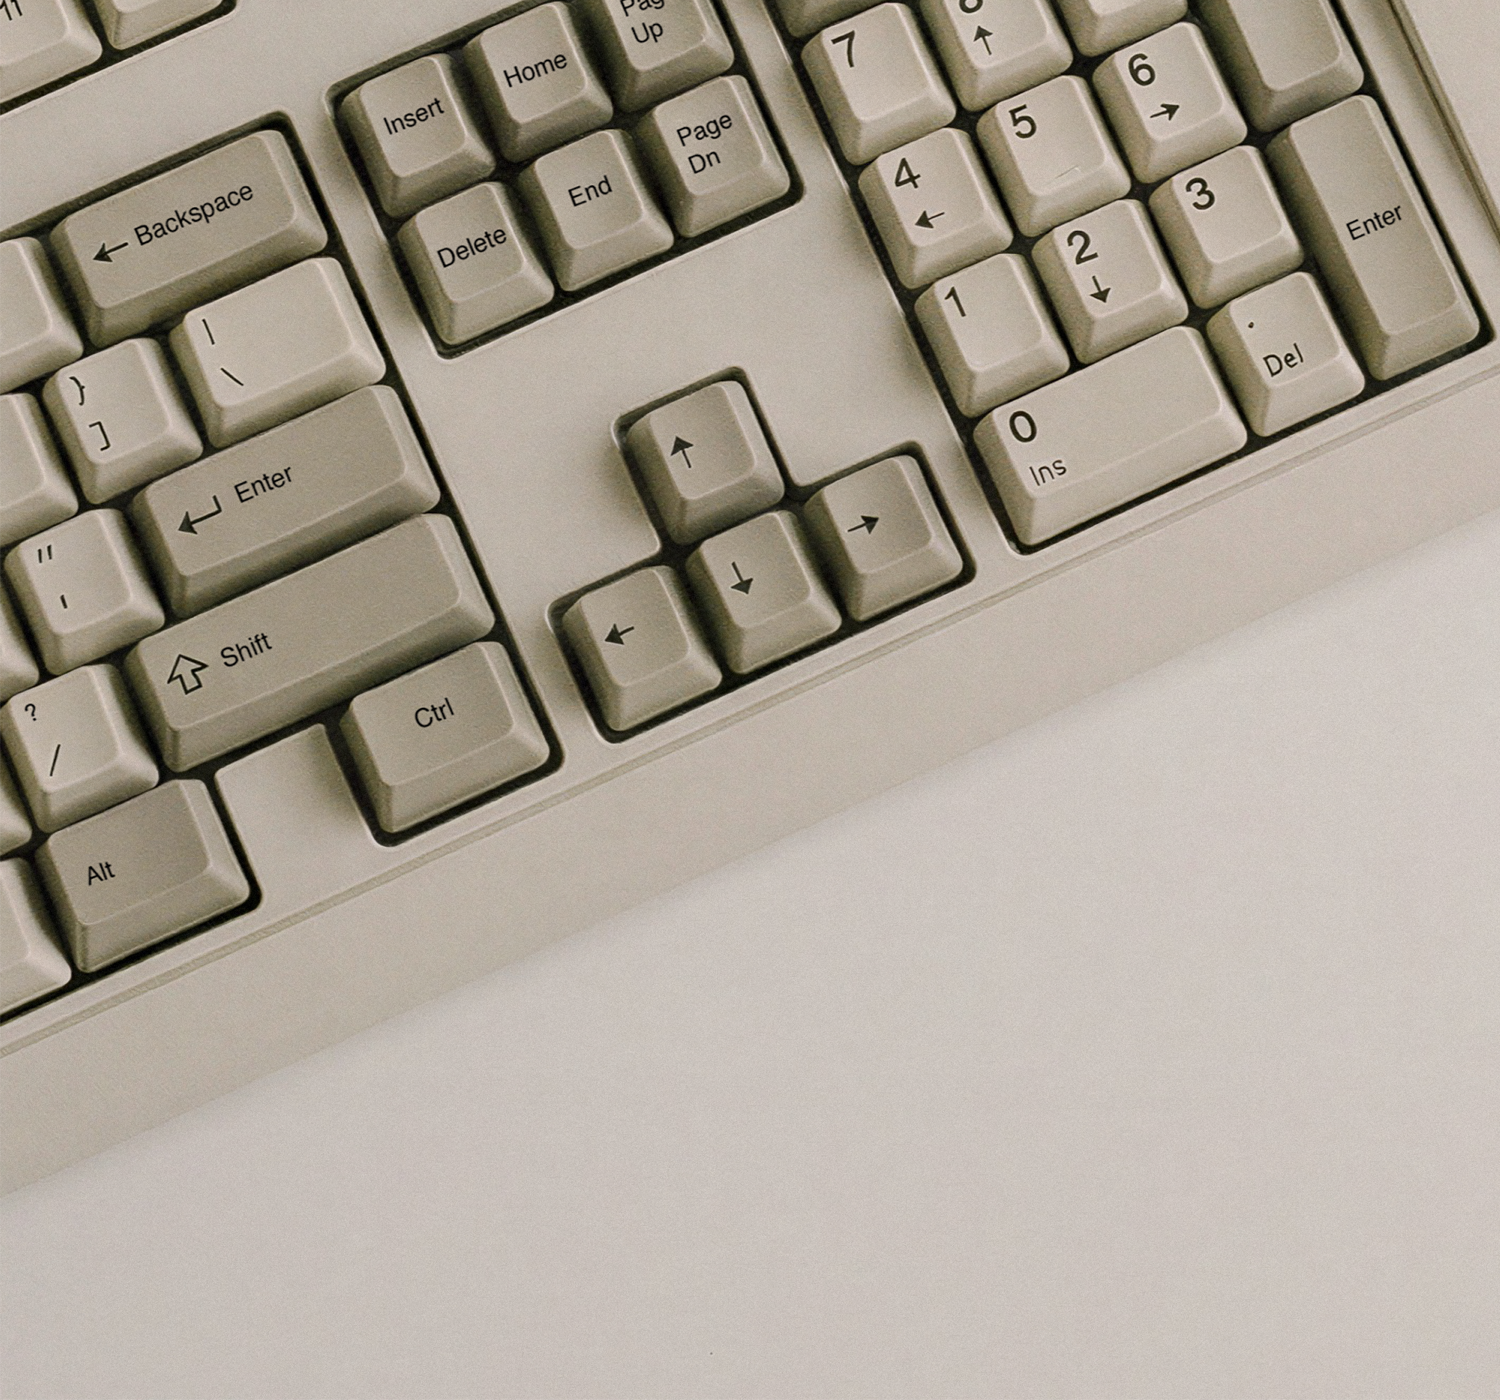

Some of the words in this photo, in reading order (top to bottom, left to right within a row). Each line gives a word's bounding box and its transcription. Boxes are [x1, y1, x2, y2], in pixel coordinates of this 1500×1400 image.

[631, 22, 664, 44] Up
[830, 30, 856, 68] 7
[503, 54, 568, 88] Home
[1128, 53, 1156, 87] 6
[383, 97, 445, 135] Insert
[676, 114, 733, 147] Page
[1008, 104, 1037, 139] 5
[687, 151, 721, 174] Dn
[894, 157, 921, 189] 4
[567, 174, 613, 207] End
[1185, 177, 1215, 210] 3
[133, 185, 254, 246] Backspace
[1345, 205, 1402, 241] Enter
[436, 228, 507, 268] Delete
[1066, 230, 1099, 265] 2
[944, 286, 966, 318] 1
[1262, 342, 1304, 378] Del
[1009, 410, 1037, 443] 0
[233, 466, 292, 504] Enter
[1029, 459, 1067, 486] Ins
[220, 632, 273, 668] Shift
[24, 703, 37, 722] ?
[414, 697, 455, 728] Ctrl
[88, 861, 116, 886] Alt
